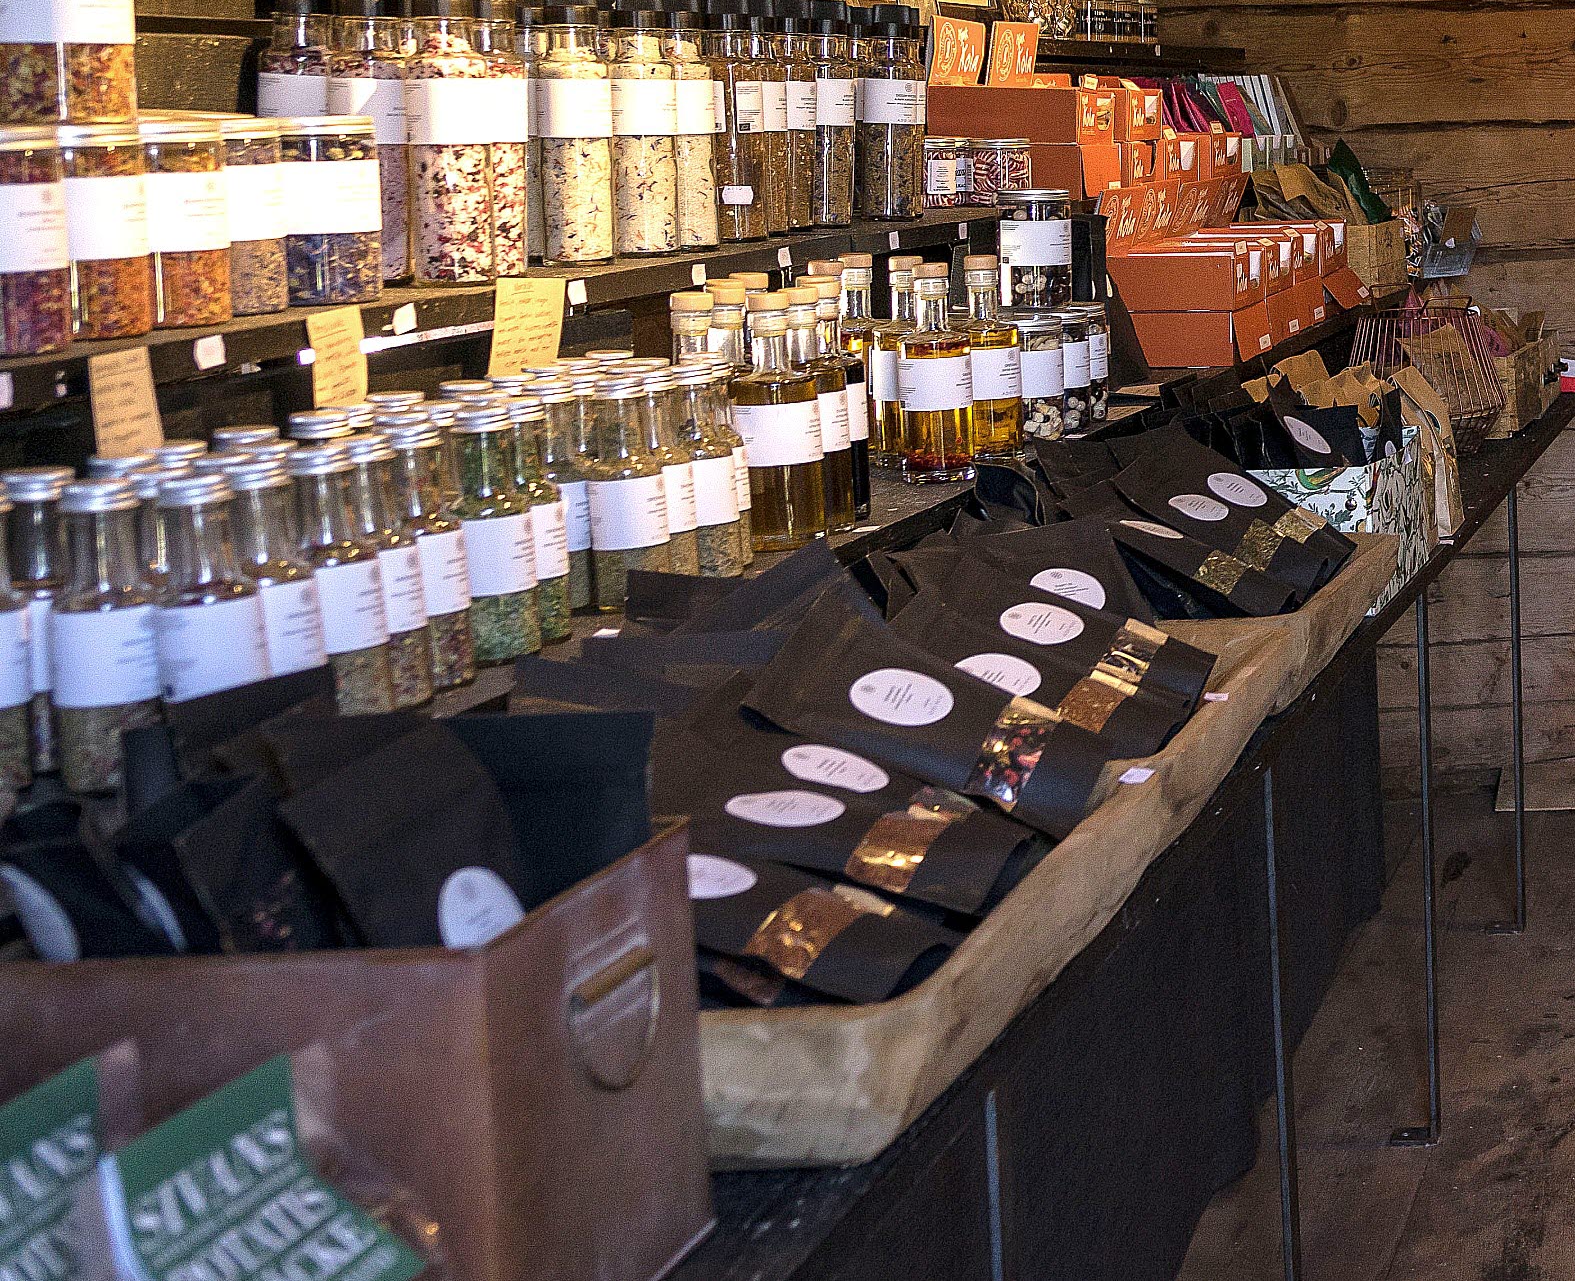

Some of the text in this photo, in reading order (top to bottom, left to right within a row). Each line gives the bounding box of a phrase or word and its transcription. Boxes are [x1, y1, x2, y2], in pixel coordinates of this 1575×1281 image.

[957, 43, 980, 73] Kola
[1015, 46, 1033, 75] Kola
[1116, 209, 1137, 240] Kola
